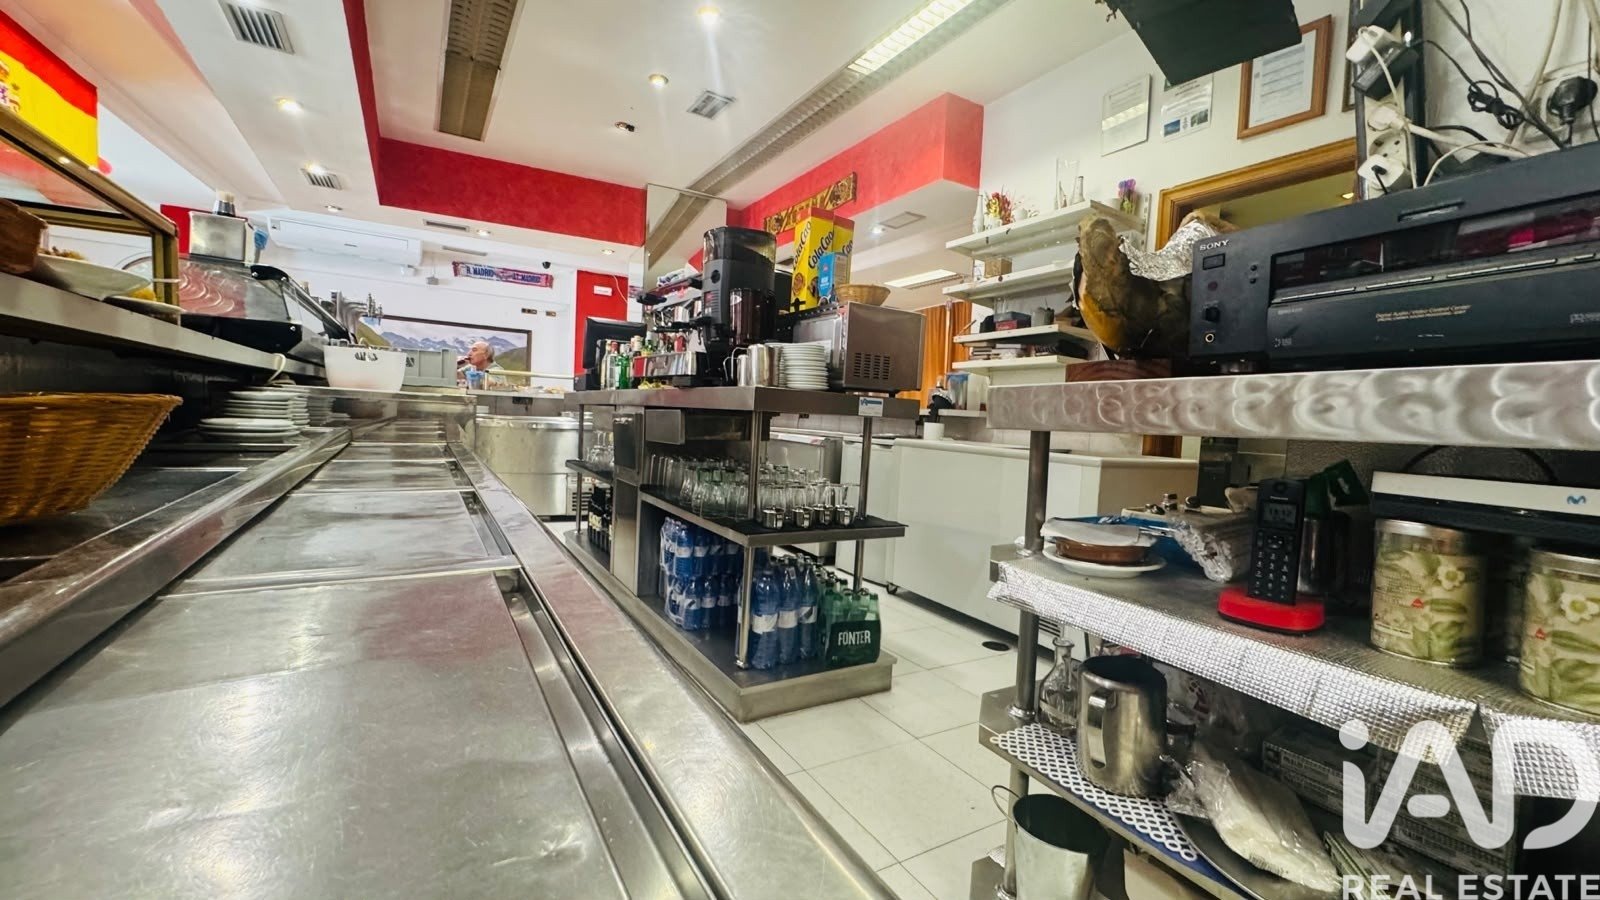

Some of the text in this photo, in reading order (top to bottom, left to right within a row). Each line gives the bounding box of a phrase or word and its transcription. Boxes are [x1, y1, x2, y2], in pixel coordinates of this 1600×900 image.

[1200, 240, 1229, 251] SONY
[473, 267, 495, 277] MADRID
[838, 630, 871, 646] FONTER
